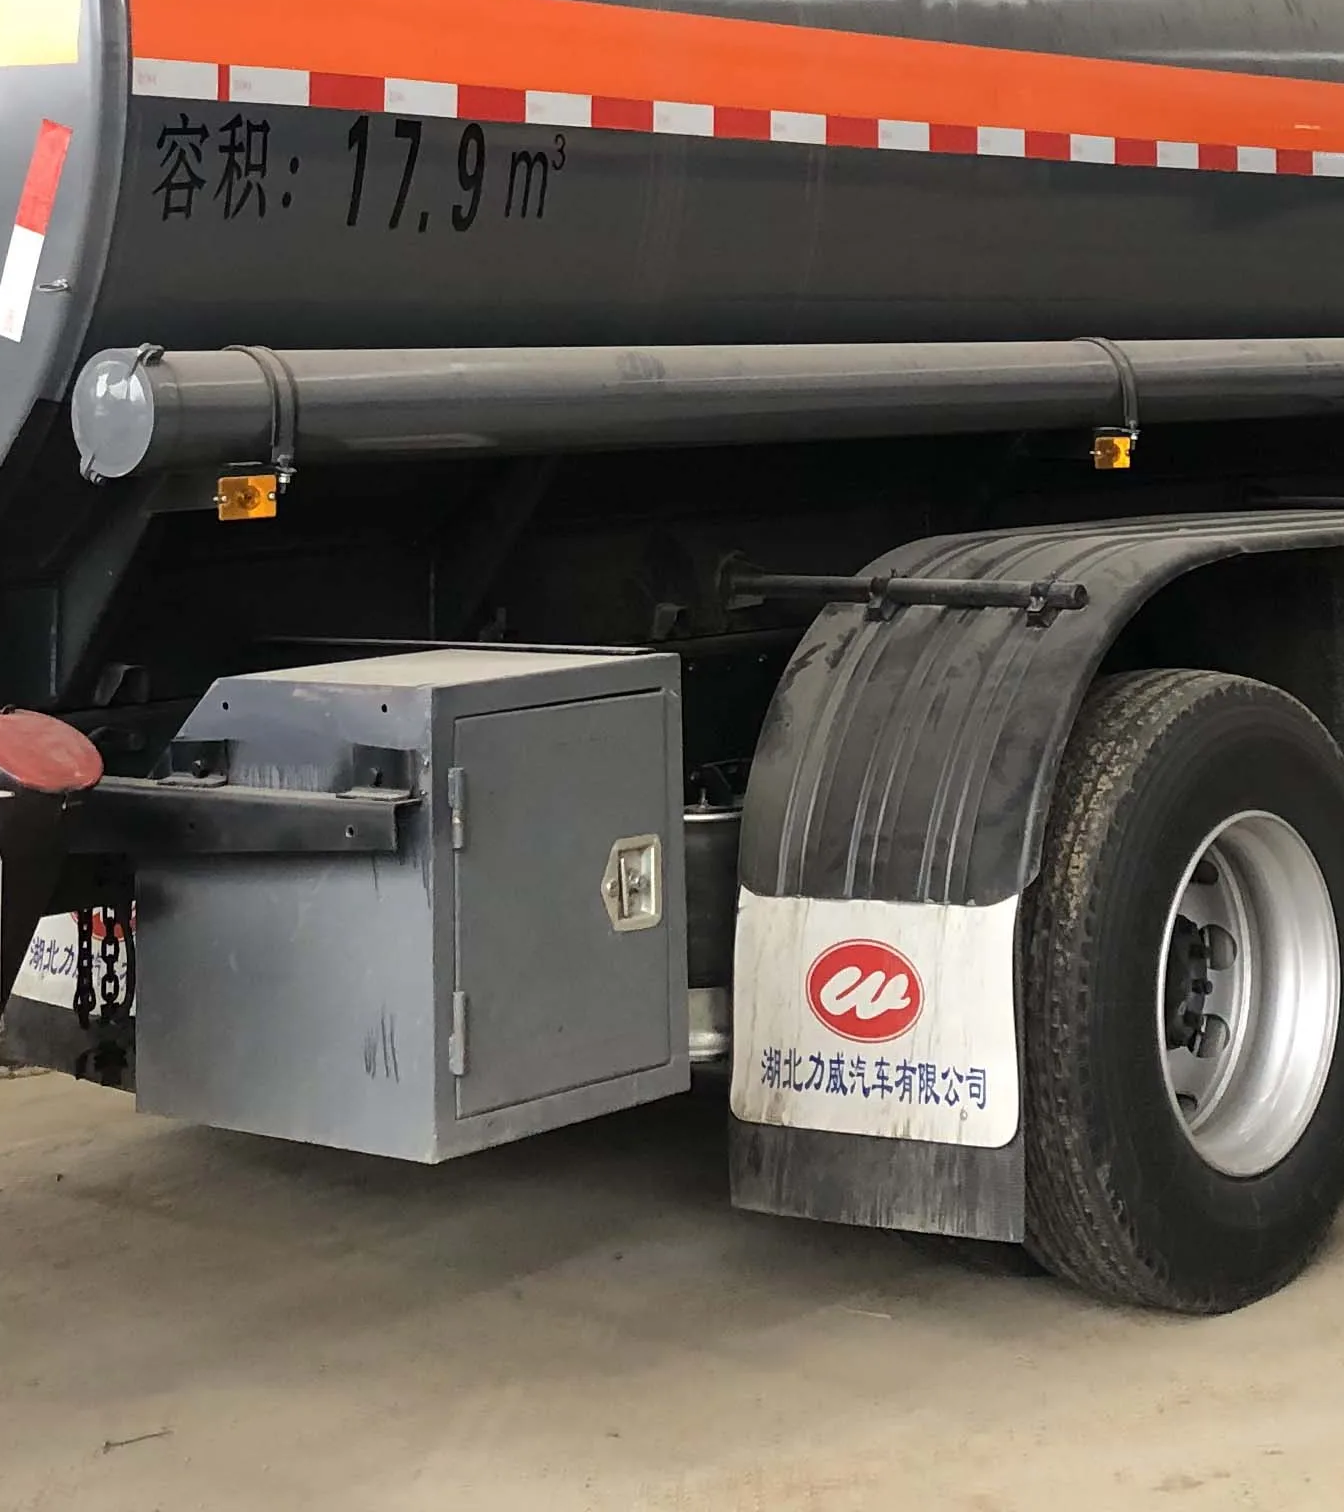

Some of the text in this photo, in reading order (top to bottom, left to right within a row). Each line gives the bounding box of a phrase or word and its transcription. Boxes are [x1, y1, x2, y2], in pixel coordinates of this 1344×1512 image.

[345, 115, 486, 233] 17.9
[761, 1046, 987, 1110] 湖北力威汽车有限公司
